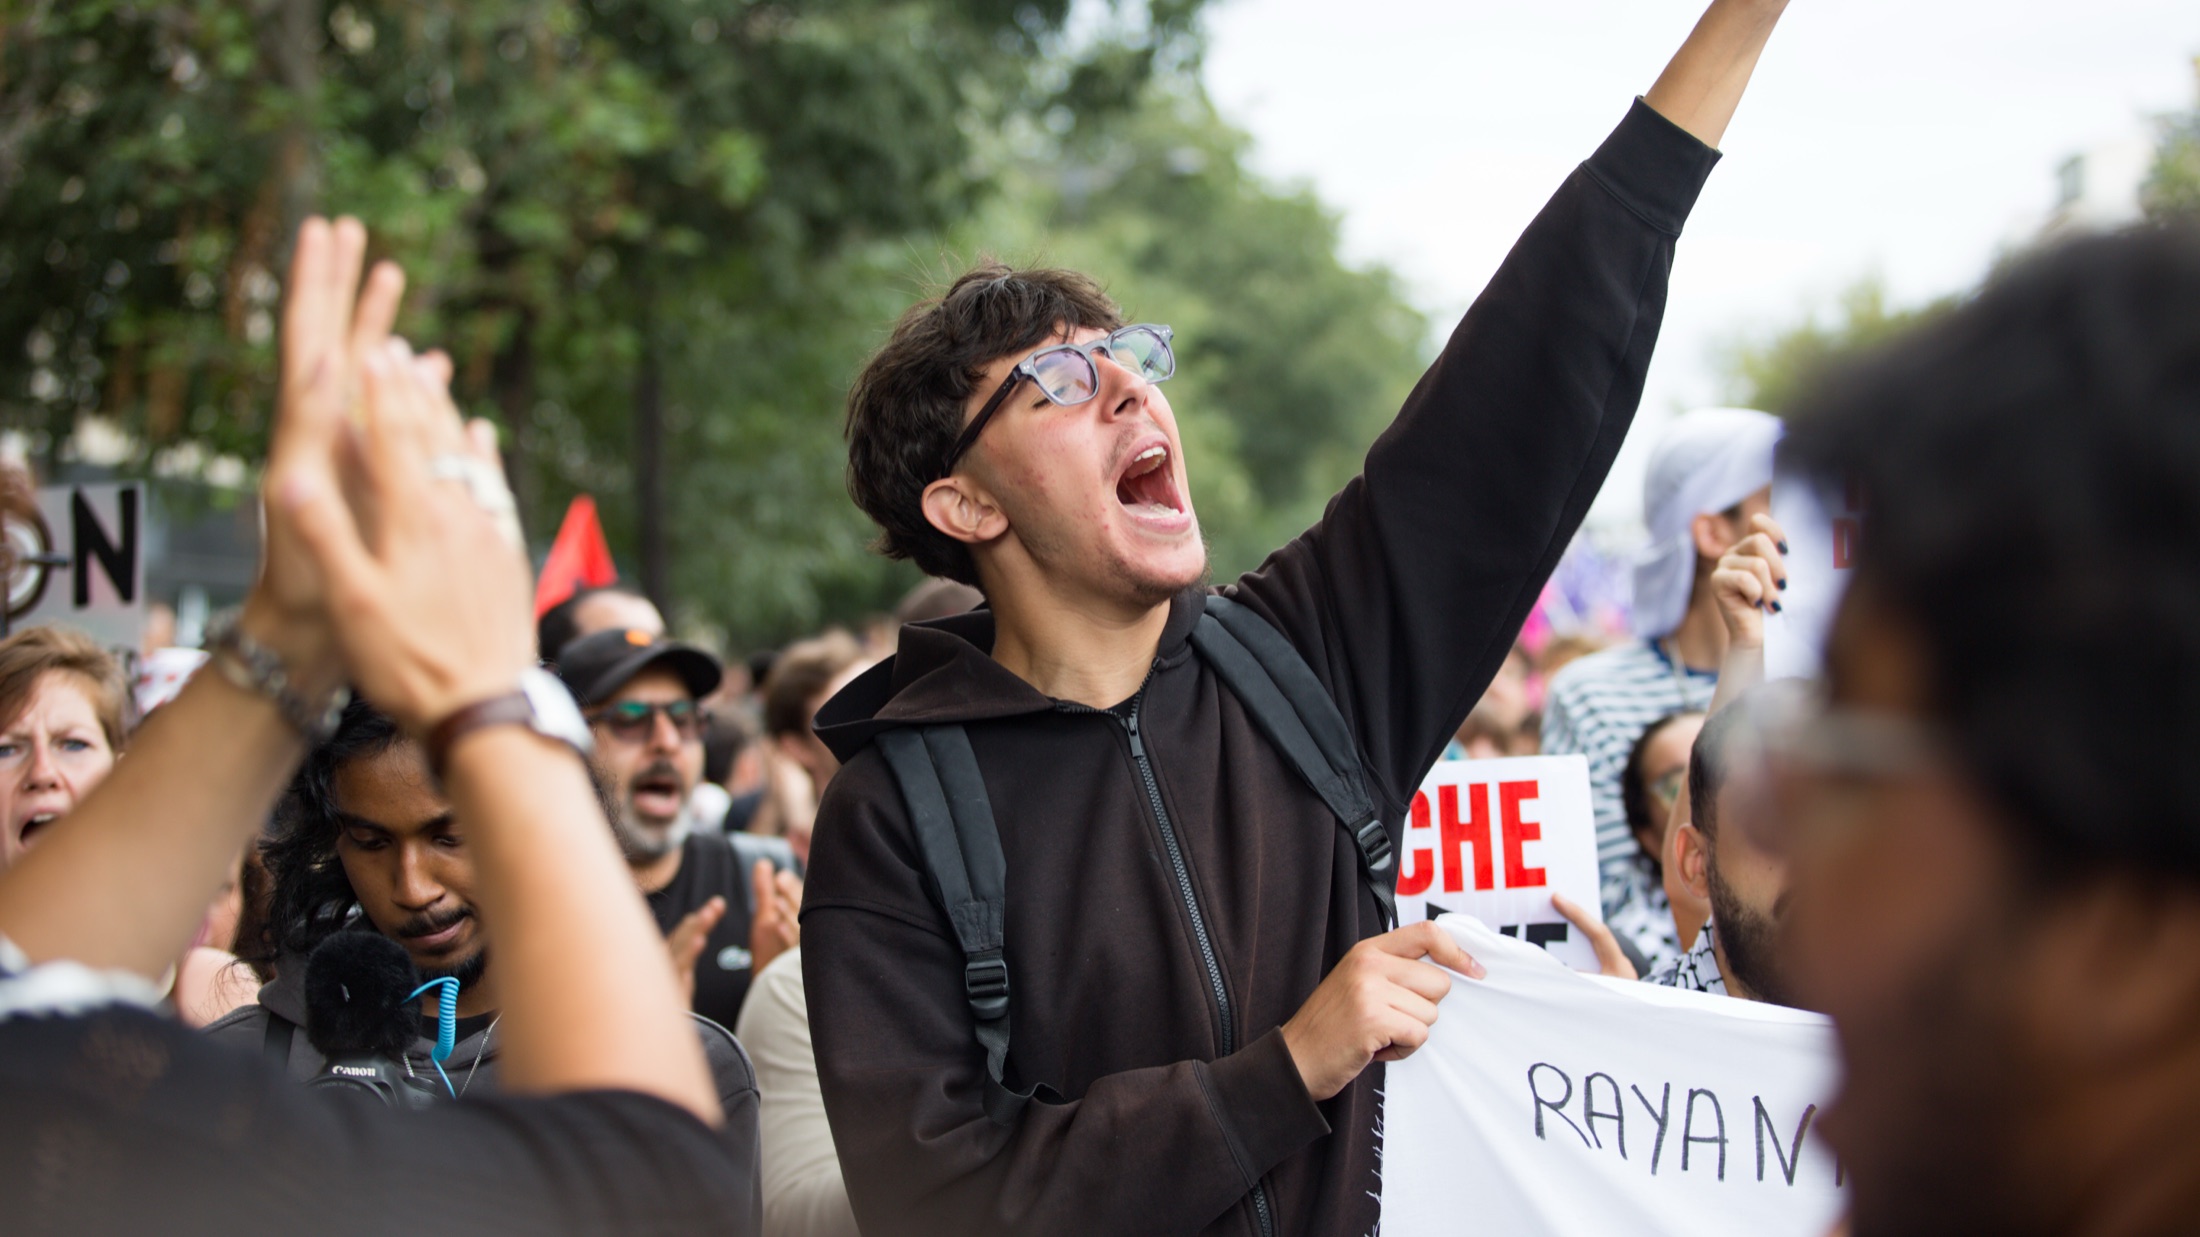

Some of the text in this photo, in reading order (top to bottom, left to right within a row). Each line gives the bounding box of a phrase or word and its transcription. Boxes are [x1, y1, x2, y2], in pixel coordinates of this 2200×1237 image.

[1395, 779, 1547, 897] CHE
[332, 1065, 376, 1077] Canon
[1527, 1062, 1846, 1188] RAYAN
